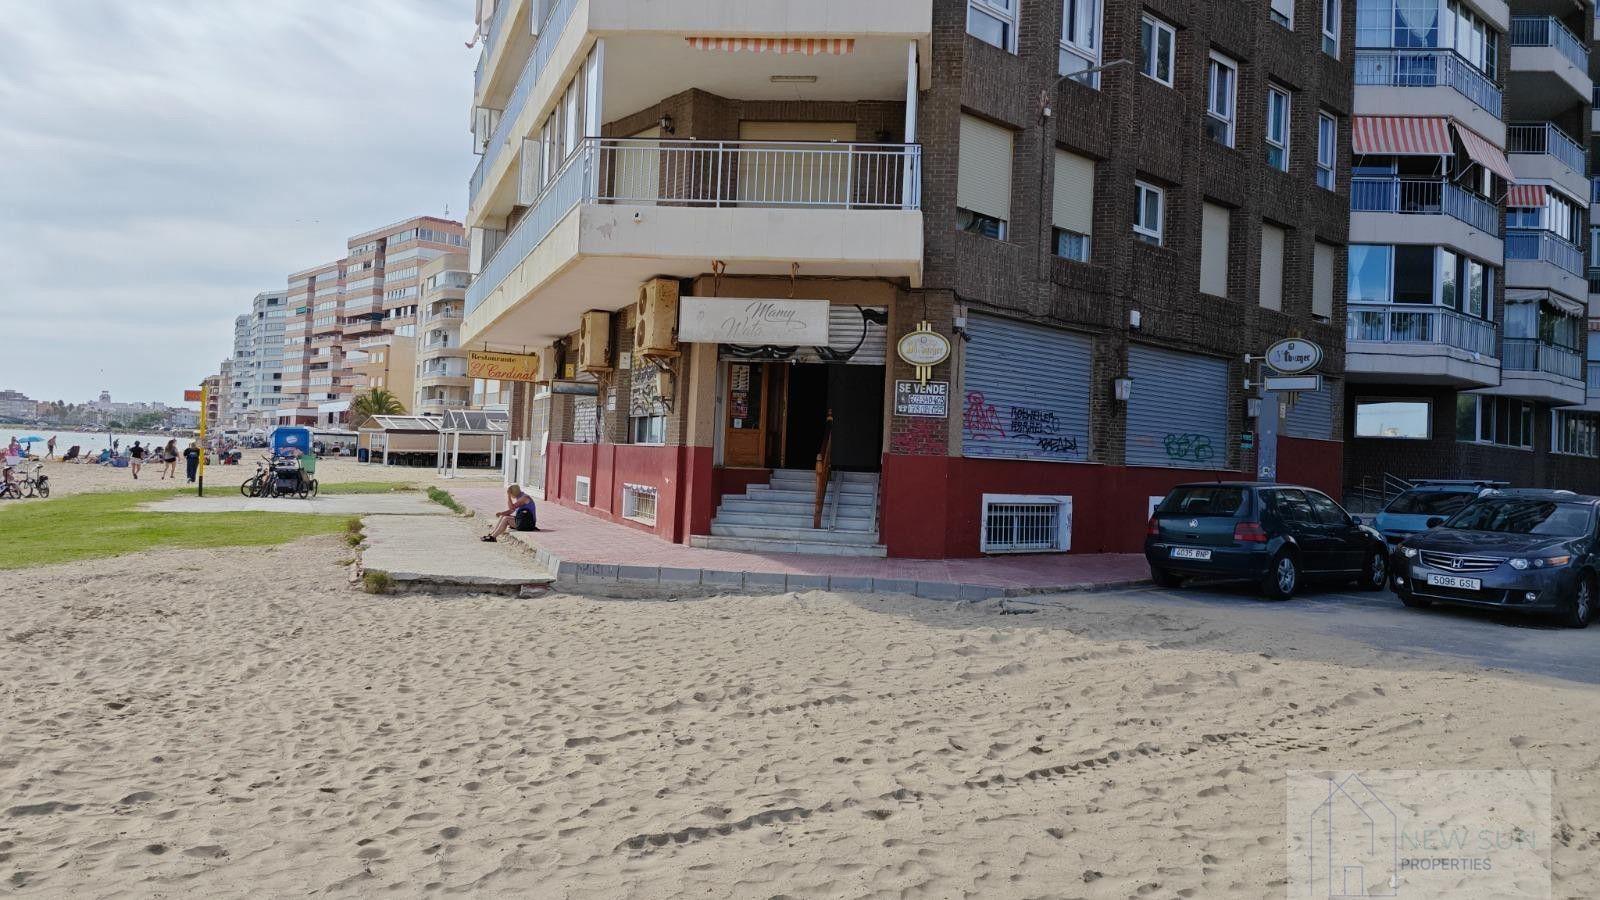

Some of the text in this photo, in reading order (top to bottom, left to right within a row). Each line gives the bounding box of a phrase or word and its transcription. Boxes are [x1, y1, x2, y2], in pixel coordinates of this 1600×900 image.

[745, 301, 806, 328] Mamy
[471, 352, 517, 364] Restaurante
[471, 361, 537, 380] El Cardinal
[898, 383, 946, 395] SE VENDE
[1195, 550, 1210, 558] BNP
[1433, 575, 1477, 588] 5096 GSL
